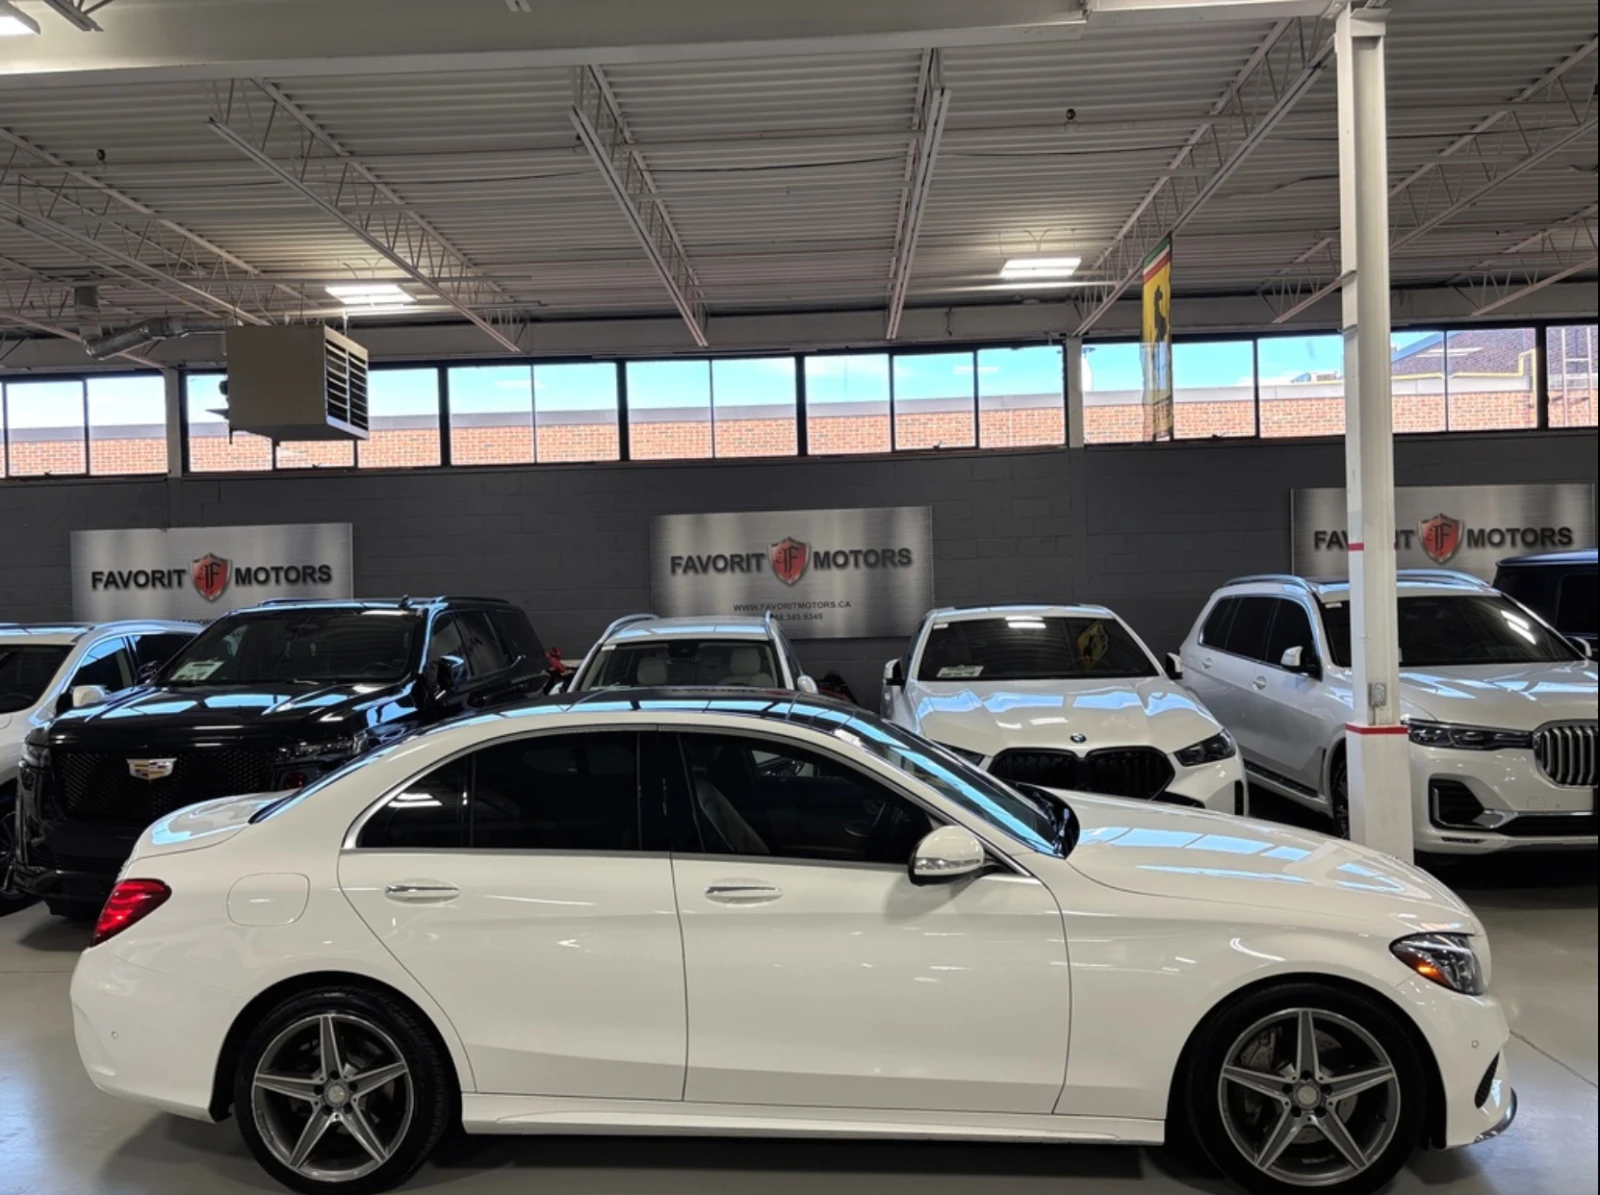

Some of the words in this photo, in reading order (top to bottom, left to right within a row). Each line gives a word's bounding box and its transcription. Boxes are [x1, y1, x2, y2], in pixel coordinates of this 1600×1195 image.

[1314, 529, 1415, 550] FAIT
[1467, 527, 1573, 548] MOTORS
[670, 553, 766, 576] FAVORIT
[813, 547, 912, 569] MOTORS
[91, 569, 186, 590] FAVORIT
[235, 564, 332, 586] MOTORS
[733, 600, 851, 612] WWW.FAVORITMOTORS.CA
